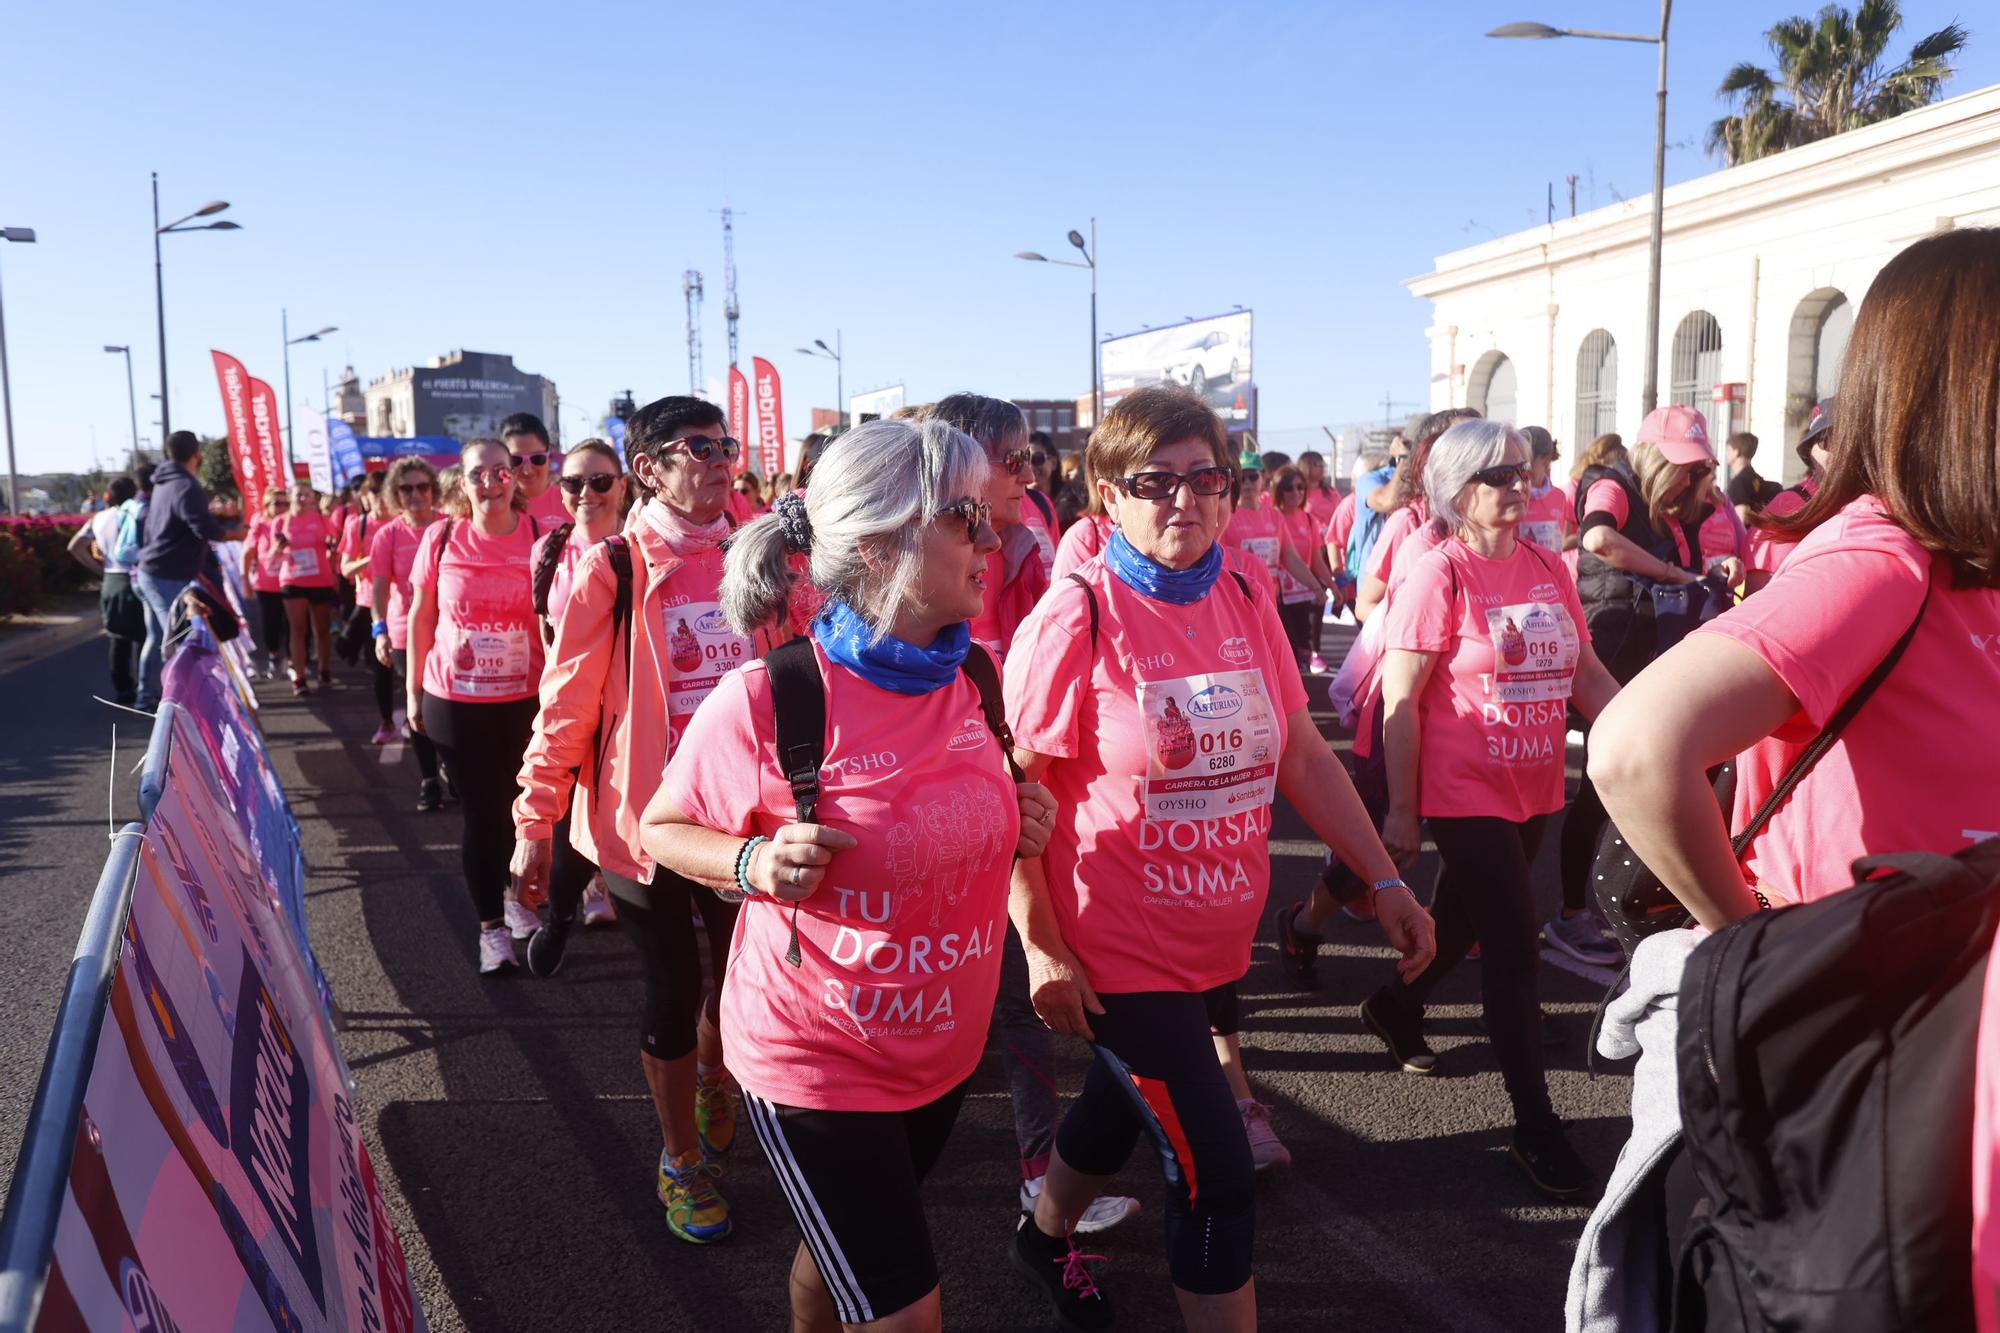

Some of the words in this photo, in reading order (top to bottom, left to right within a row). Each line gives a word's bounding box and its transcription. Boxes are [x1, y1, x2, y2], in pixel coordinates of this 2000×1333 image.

[663, 594, 690, 608] SHO
[705, 642, 742, 659] 016
[1529, 641, 1558, 656] 016
[478, 658, 504, 668] 016
[682, 679, 714, 690] CARRERA
[1478, 673, 1492, 695] T
[1200, 729, 1243, 753] 016
[1487, 735, 1553, 760] SUMA
[817, 751, 897, 783] OYSHO
[1209, 755, 1235, 770] 6280
[1165, 780, 1206, 790] CARRERA
[1209, 778, 1219, 787] DE
[1220, 776, 1229, 784] LA
[1158, 799, 1206, 811] OYSHO
[1139, 804, 1268, 852] DORSAL
[1143, 858, 1250, 895] SUMA
[833, 886, 891, 923] TU
[830, 920, 994, 974] DORSAL
[823, 978, 953, 1024] SUMA
[933, 1020, 956, 1033] 2023
